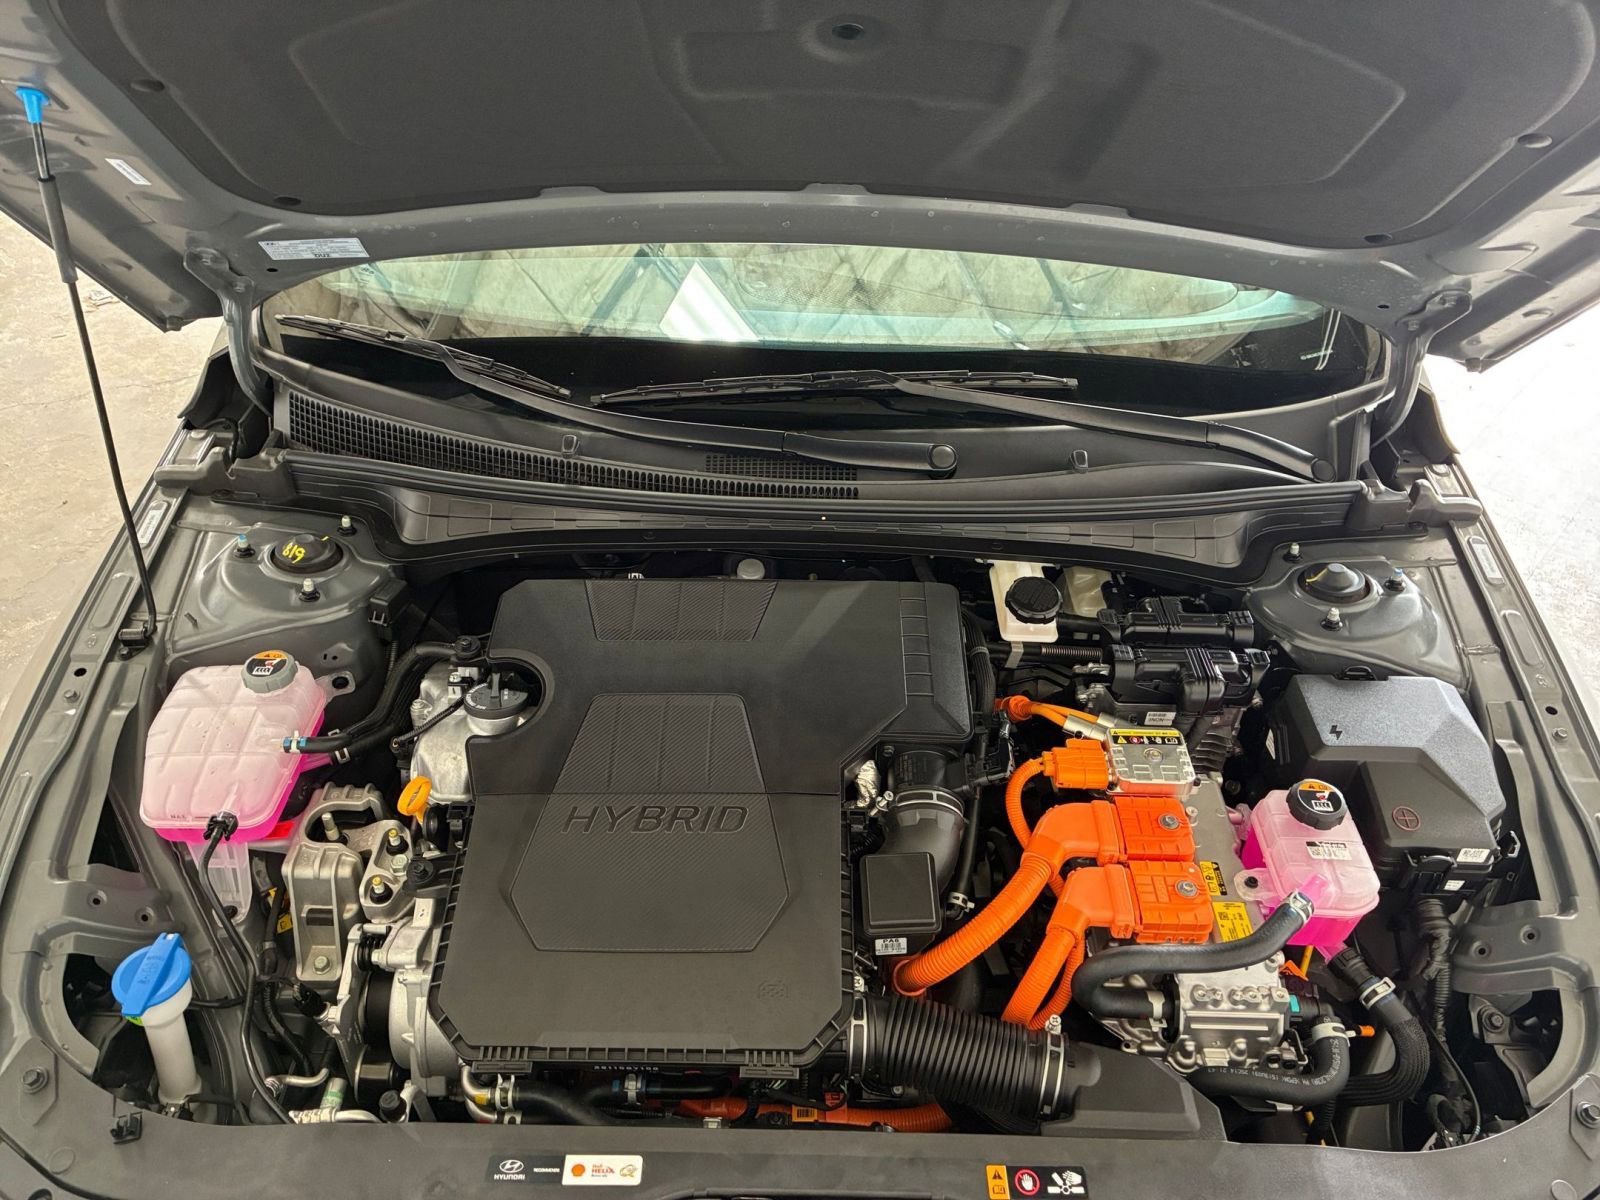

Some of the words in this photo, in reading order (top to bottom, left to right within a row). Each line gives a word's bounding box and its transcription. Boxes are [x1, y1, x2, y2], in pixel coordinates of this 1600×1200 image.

[561, 805, 749, 834] HYBRID
[592, 1166, 615, 1174] HELIX
[494, 1173, 525, 1181] HYUNDAI
